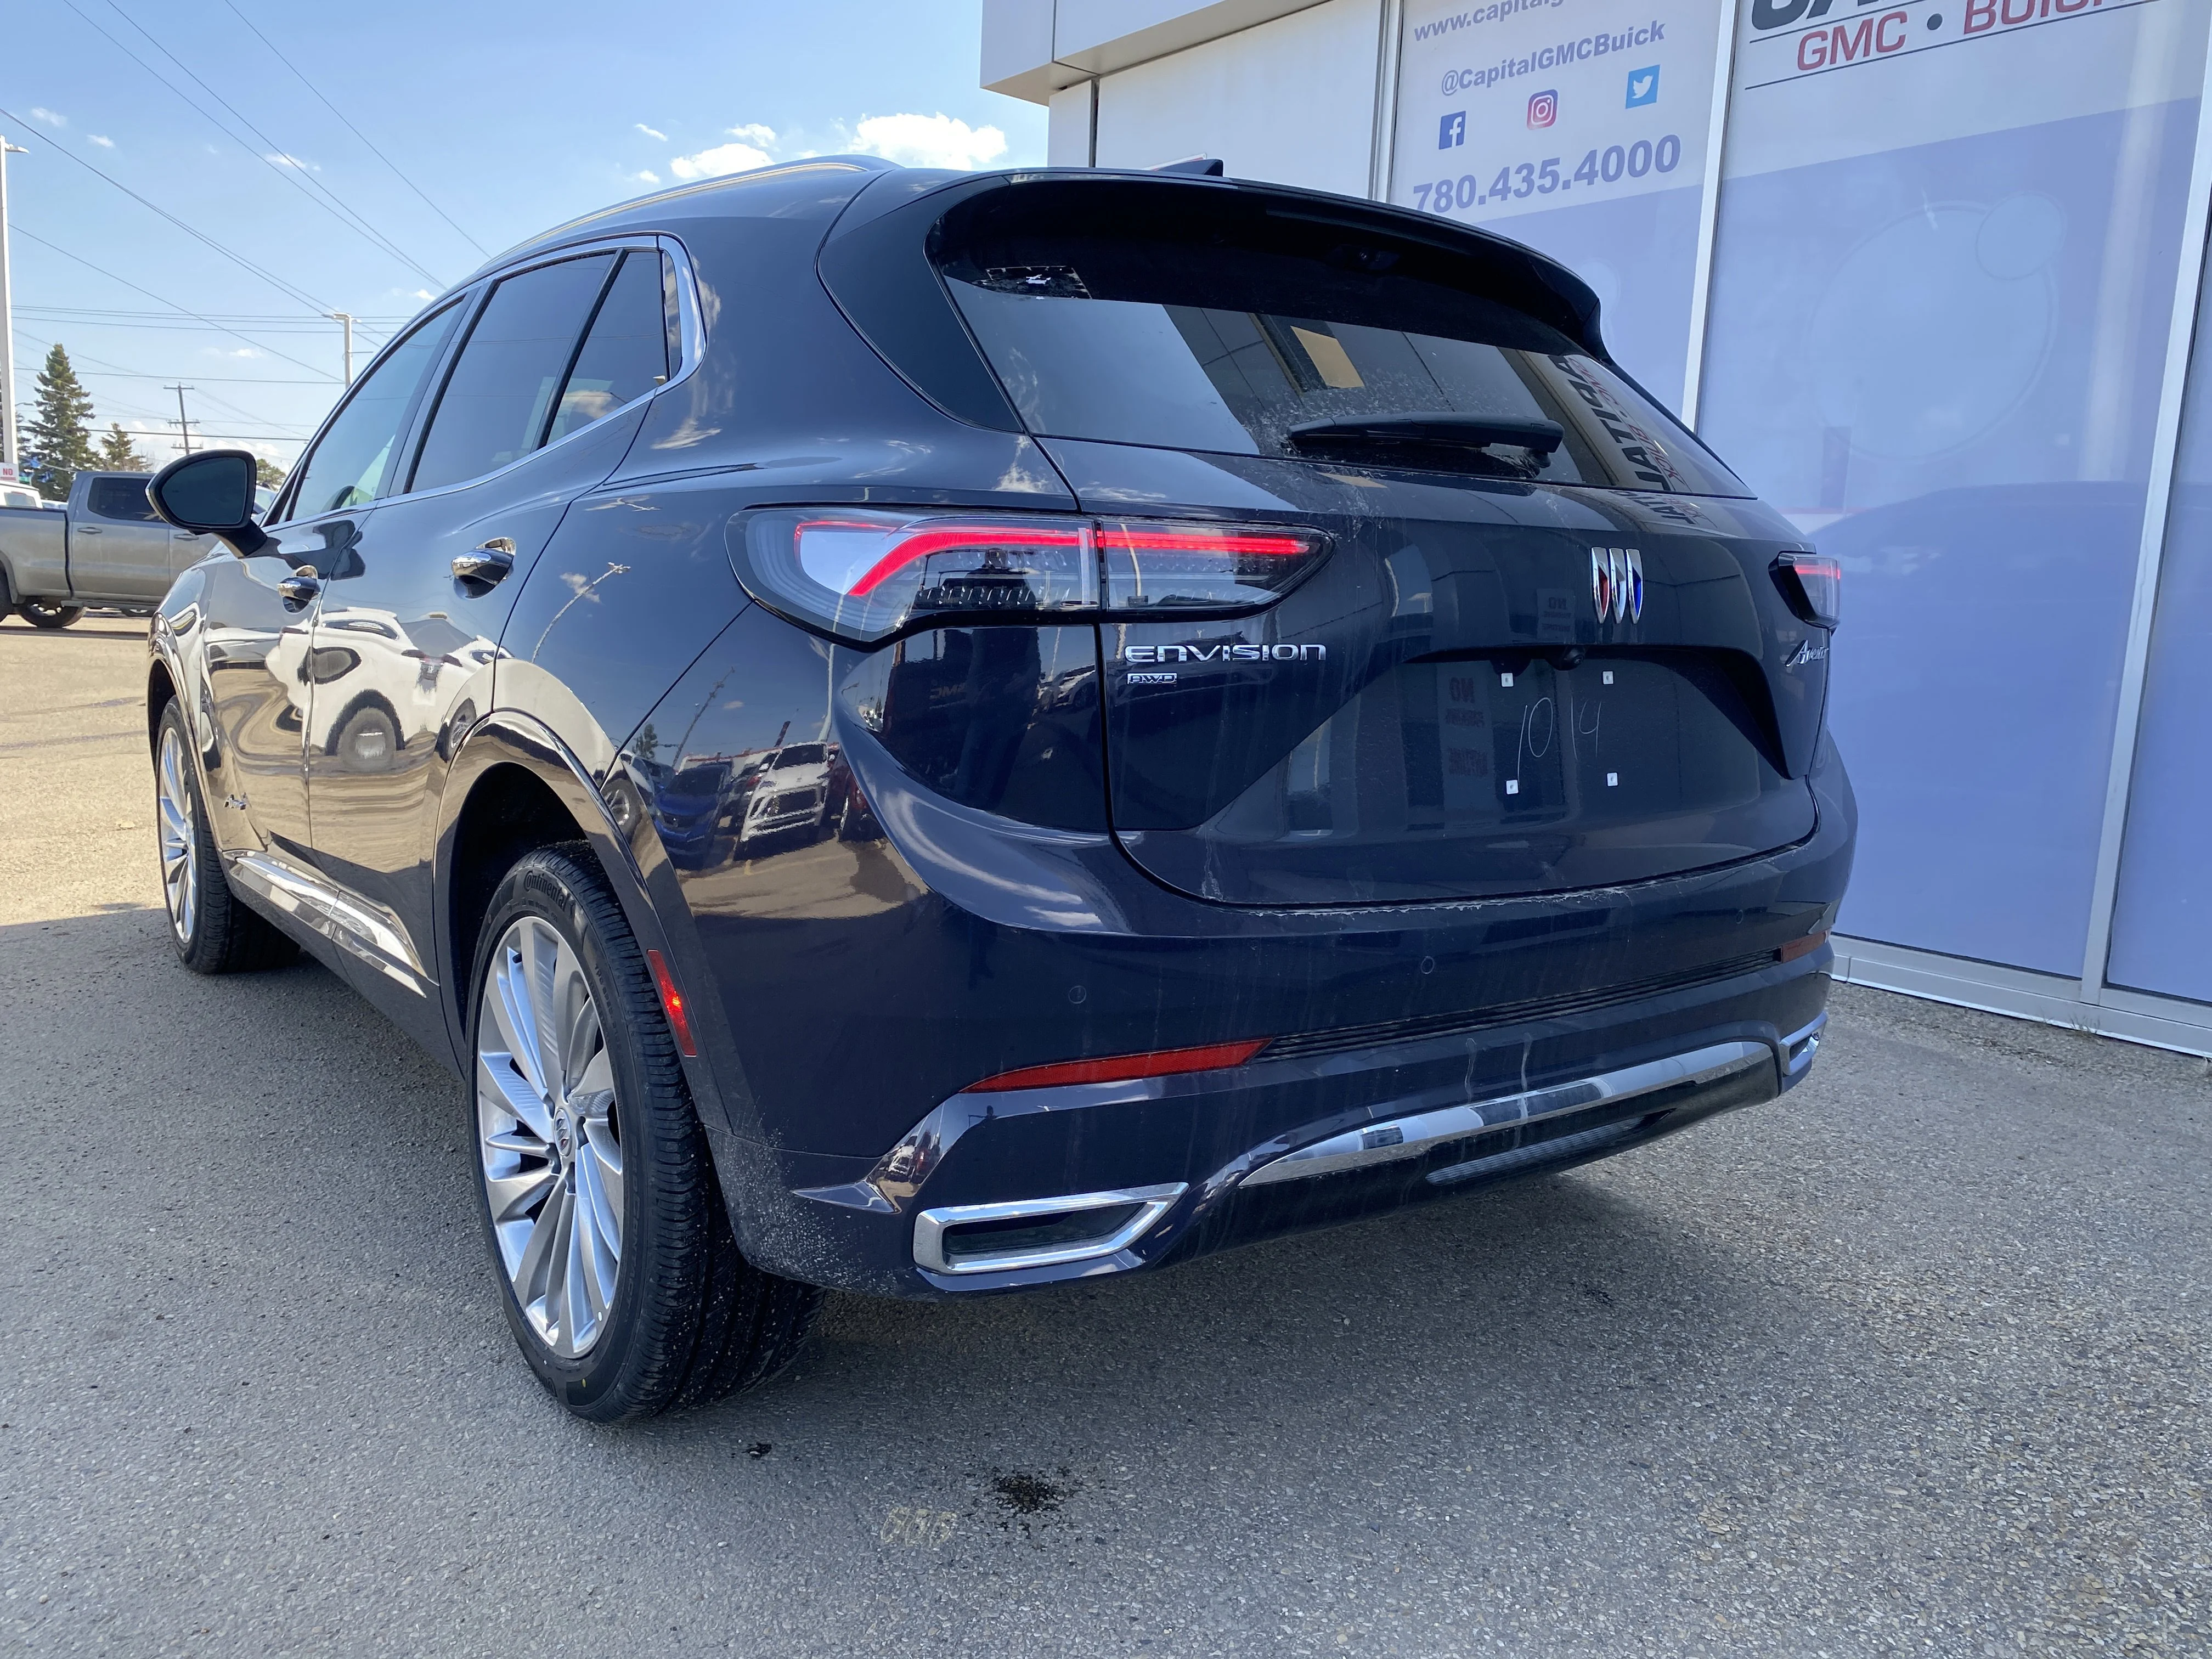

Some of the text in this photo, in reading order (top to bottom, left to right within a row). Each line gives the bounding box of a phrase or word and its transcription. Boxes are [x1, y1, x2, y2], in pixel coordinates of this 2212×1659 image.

[1441, 20, 1666, 96] @CapitalGMCBuick
[1797, 10, 1908, 71] GMC
[1413, 134, 1681, 213] 780.435.4000
[3, 467, 13, 476] NO
[1130, 674, 1176, 684] AWD
[523, 870, 571, 912] Continental
